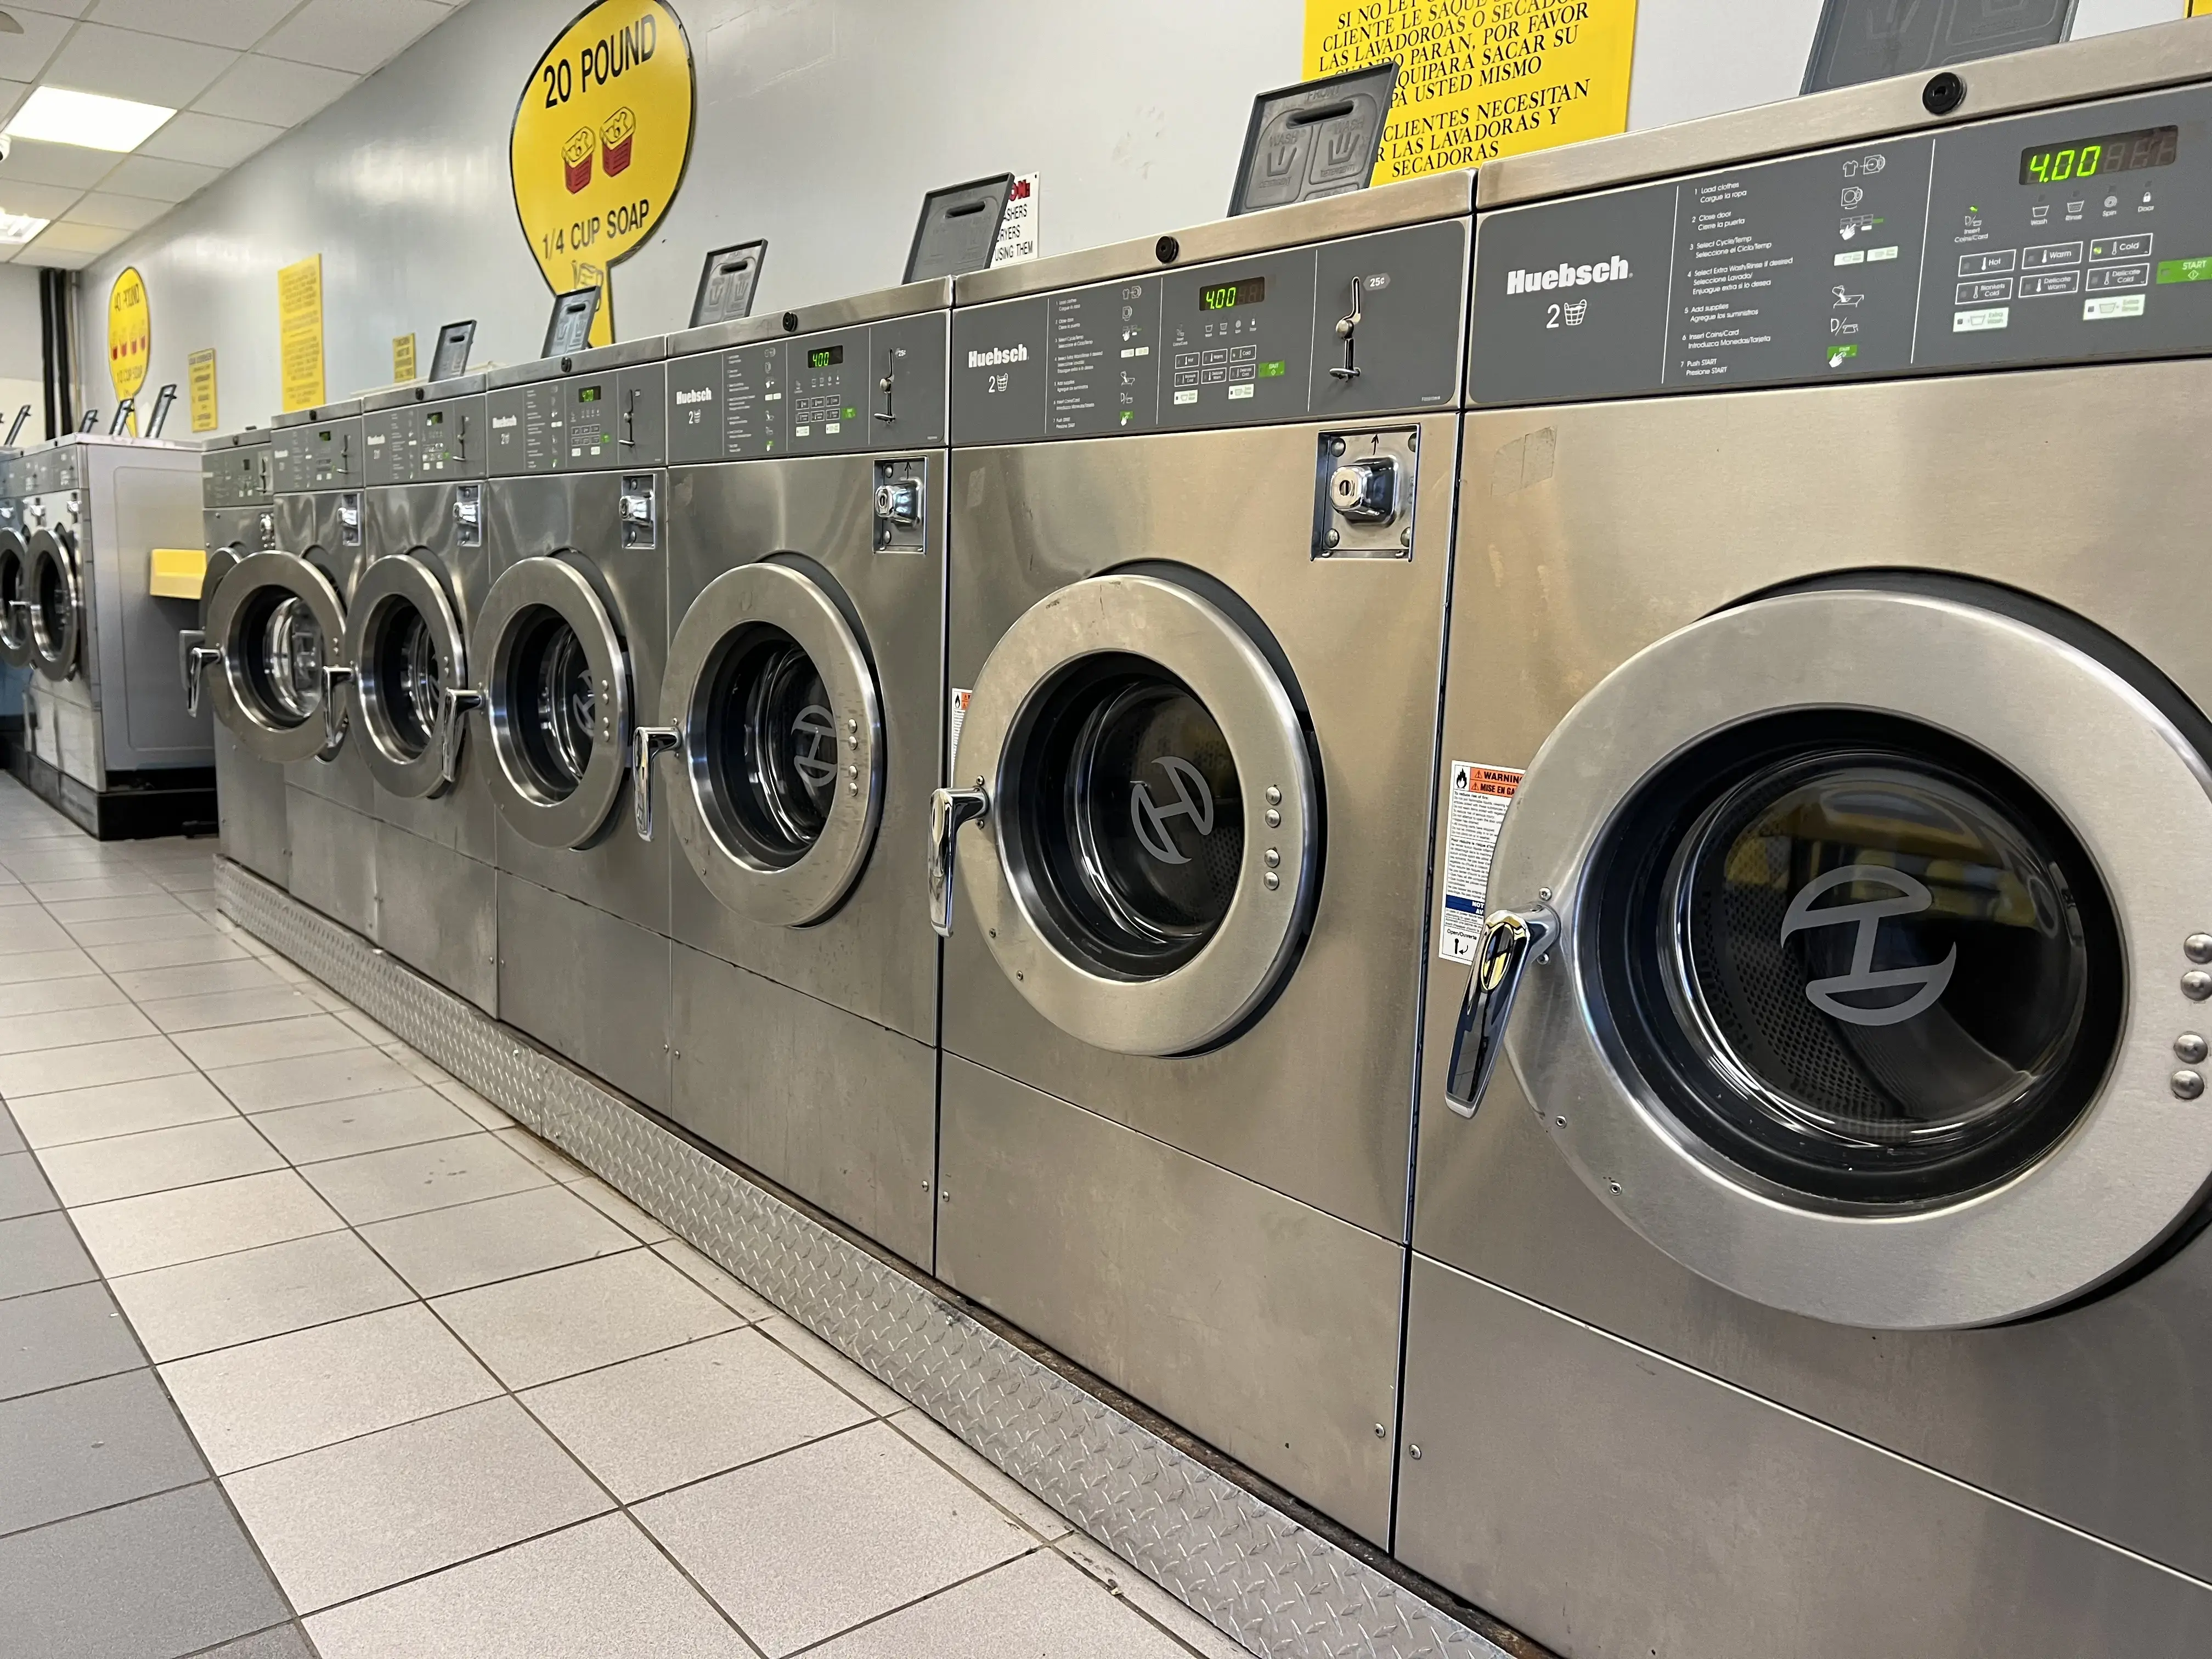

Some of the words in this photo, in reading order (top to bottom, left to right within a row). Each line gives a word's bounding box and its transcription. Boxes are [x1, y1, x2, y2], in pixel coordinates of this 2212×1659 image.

[1338, 12, 1351, 30] SI
[1358, 3, 1381, 24] NO
[1323, 17, 1395, 52] CLIENTE
[1402, 9, 1423, 31] LE
[1411, 33, 1476, 66] PARAN,
[1483, 21, 1520, 46] POR
[1528, 2, 1589, 34] FAVOR
[1319, 49, 1349, 72] LAS
[1355, 15, 1466, 62] LAVADOROAS
[1472, 10, 1486, 28] O
[1482, 35, 1546, 66] SACAR
[1553, 25, 1579, 48] SU
[543, 58, 572, 110] 20
[581, 13, 658, 94] POUND
[1415, 74, 1472, 103] USTED
[1479, 55, 1542, 87] MISMO
[1383, 108, 1470, 143] CLIENTES
[1476, 78, 1591, 121] NECESITAN
[1392, 137, 1424, 159] LAS
[1430, 111, 1540, 151] LAVADORAS
[1548, 106, 1562, 125] Y
[1392, 140, 1499, 177] SECADORAS
[2030, 146, 2101, 183] 4.00
[1701, 185, 1716, 194] Load
[1718, 182, 1739, 191] clothes
[1700, 194, 1723, 203] Cargue
[1699, 213, 1716, 222] Close
[1724, 218, 1745, 228] puerta
[542, 227, 565, 261] 1/4
[571, 216, 600, 251] CUP
[607, 198, 650, 239] SOAP
[1017, 240, 1033, 256] THEM
[1697, 240, 1714, 249] Select
[2119, 241, 2140, 251] Cold
[1696, 249, 1729, 258] Seleccione
[2050, 250, 2072, 259] Warm
[1694, 268, 1712, 276] Select
[1729, 262, 1763, 272] Wash/Rinse
[1769, 257, 1793, 266] desired
[1988, 257, 2001, 267] Hot
[2182, 259, 2207, 270] START
[1507, 255, 1629, 295] Huebsch
[1694, 275, 1726, 285] Seleccione
[2117, 275, 2134, 284] Cold
[1692, 285, 1720, 295] Enjuague
[1722, 282, 1737, 291] extra
[1984, 289, 2000, 297] Cold
[2047, 283, 2066, 291] Warm
[1206, 287, 1236, 309] 4.00
[1691, 304, 1703, 313] Add
[1705, 303, 1729, 312] supplies
[1546, 303, 1560, 329] 2
[1690, 313, 1716, 323] Agregue
[1726, 309, 1758, 318] suministros
[1688, 340, 1719, 348] Introduzca
[968, 344, 1027, 368] Huebsch
[1686, 368, 1710, 376] Presione
[989, 376, 995, 393] 2
[676, 387, 712, 404] Huebsch
[689, 411, 693, 424] 2
[1480, 783, 1495, 792] MISE
